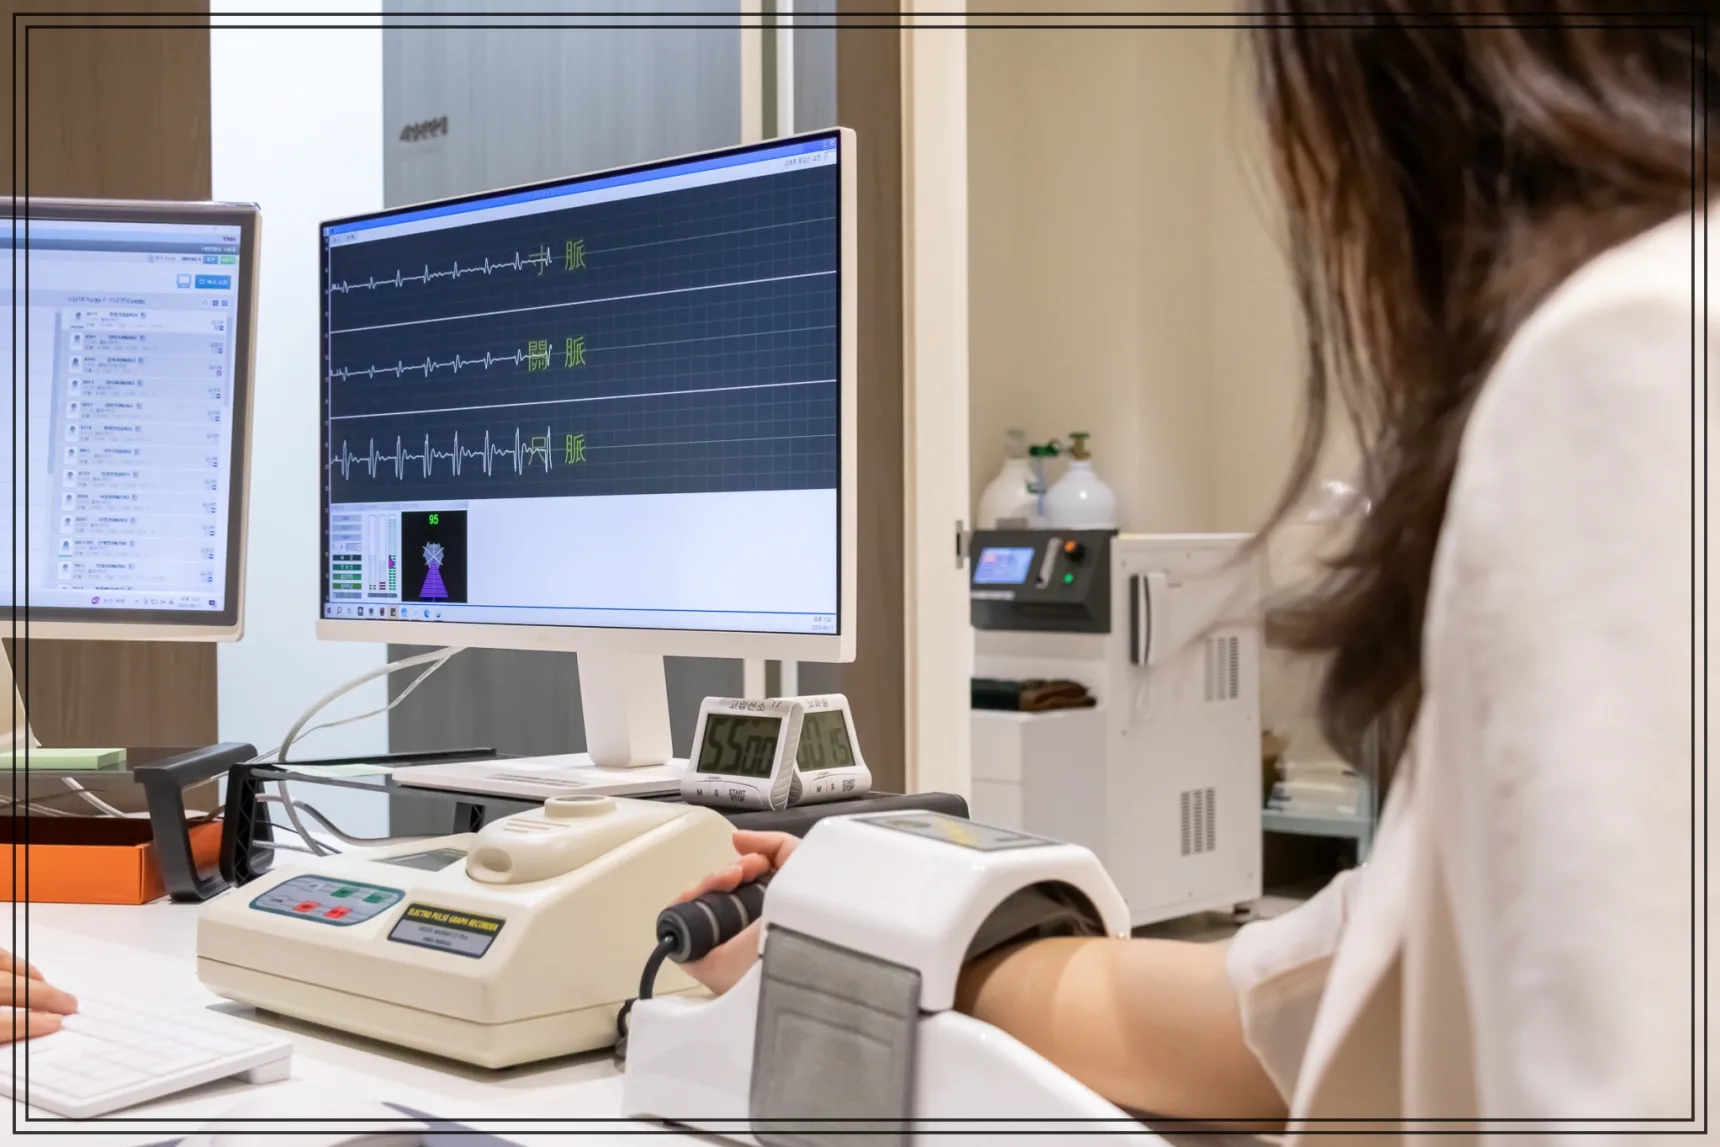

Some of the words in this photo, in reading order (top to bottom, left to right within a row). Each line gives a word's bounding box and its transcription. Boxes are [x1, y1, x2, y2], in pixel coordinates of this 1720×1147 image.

[565, 239, 586, 271] 脈
[565, 336, 586, 368] 脈
[565, 434, 586, 464] 脈
[429, 514, 439, 525] 95
[697, 788, 702, 796] M
[714, 789, 719, 797] S
[728, 789, 745, 797] START
[408, 908, 432, 918] ELECTRO
[432, 912, 449, 921] PULSE
[449, 916, 469, 925] GRAPH
[468, 919, 498, 931] RECORDER
